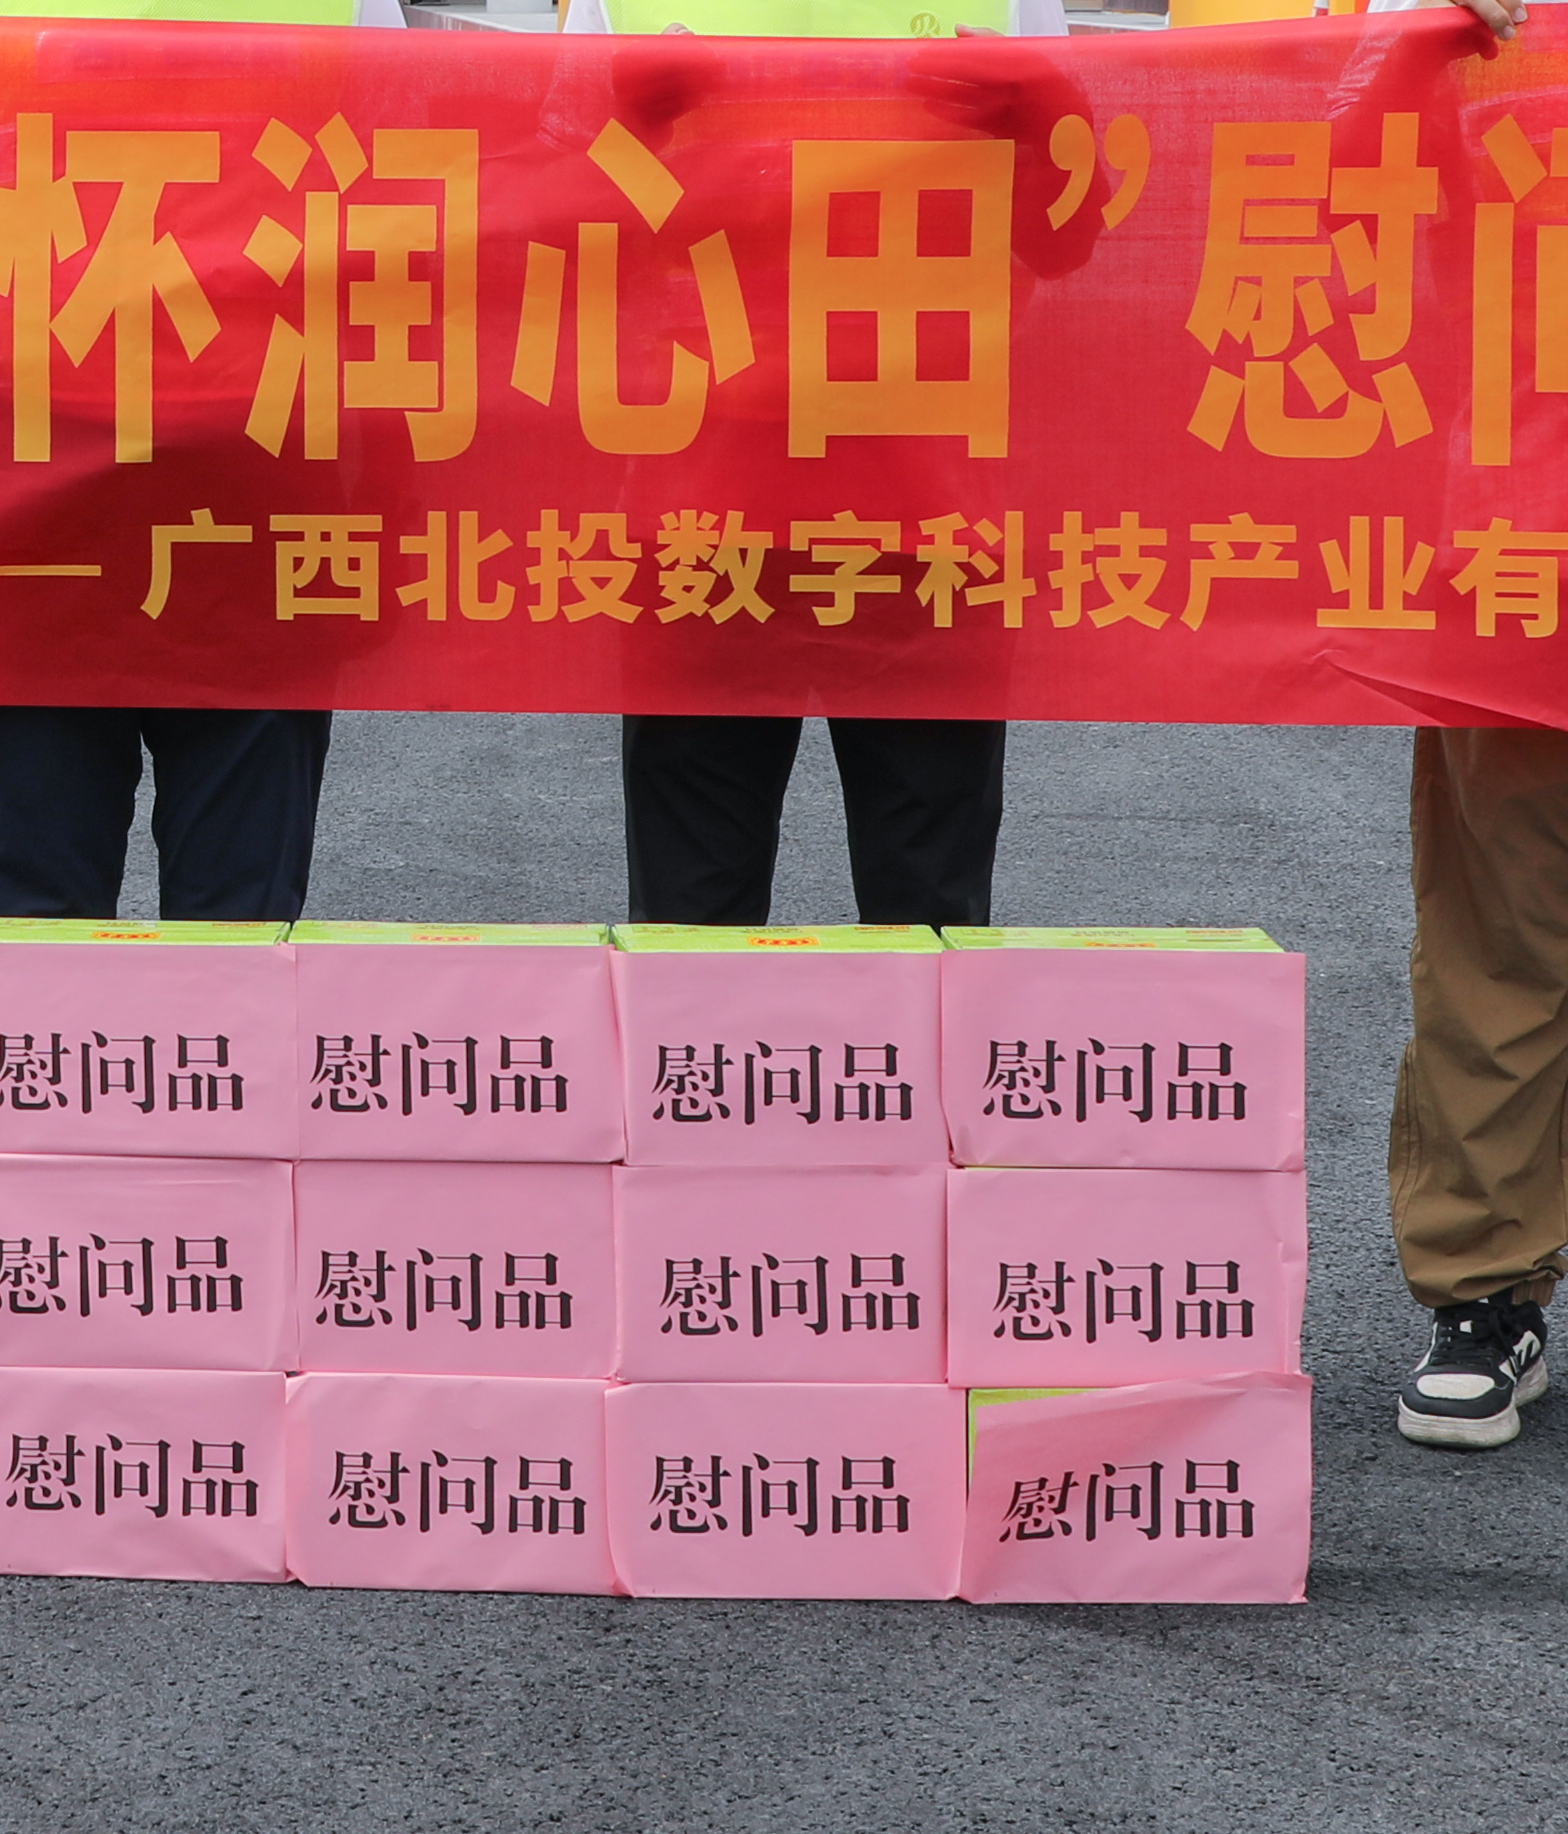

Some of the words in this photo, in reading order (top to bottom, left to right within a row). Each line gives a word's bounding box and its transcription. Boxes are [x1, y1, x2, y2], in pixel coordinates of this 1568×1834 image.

[310, 1032, 569, 1116] 慰问品
[652, 1040, 914, 1125] 慰问品
[982, 1038, 1248, 1123] 慰问品
[316, 1248, 573, 1331] 慰问品
[660, 1252, 921, 1337] 慰问品
[993, 1259, 1255, 1343] 慰问品
[5, 1433, 259, 1518] 慰问品
[328, 1450, 587, 1534] 慰问品
[649, 1453, 910, 1537] 慰问品
[999, 1459, 1255, 1543] 慰问品
